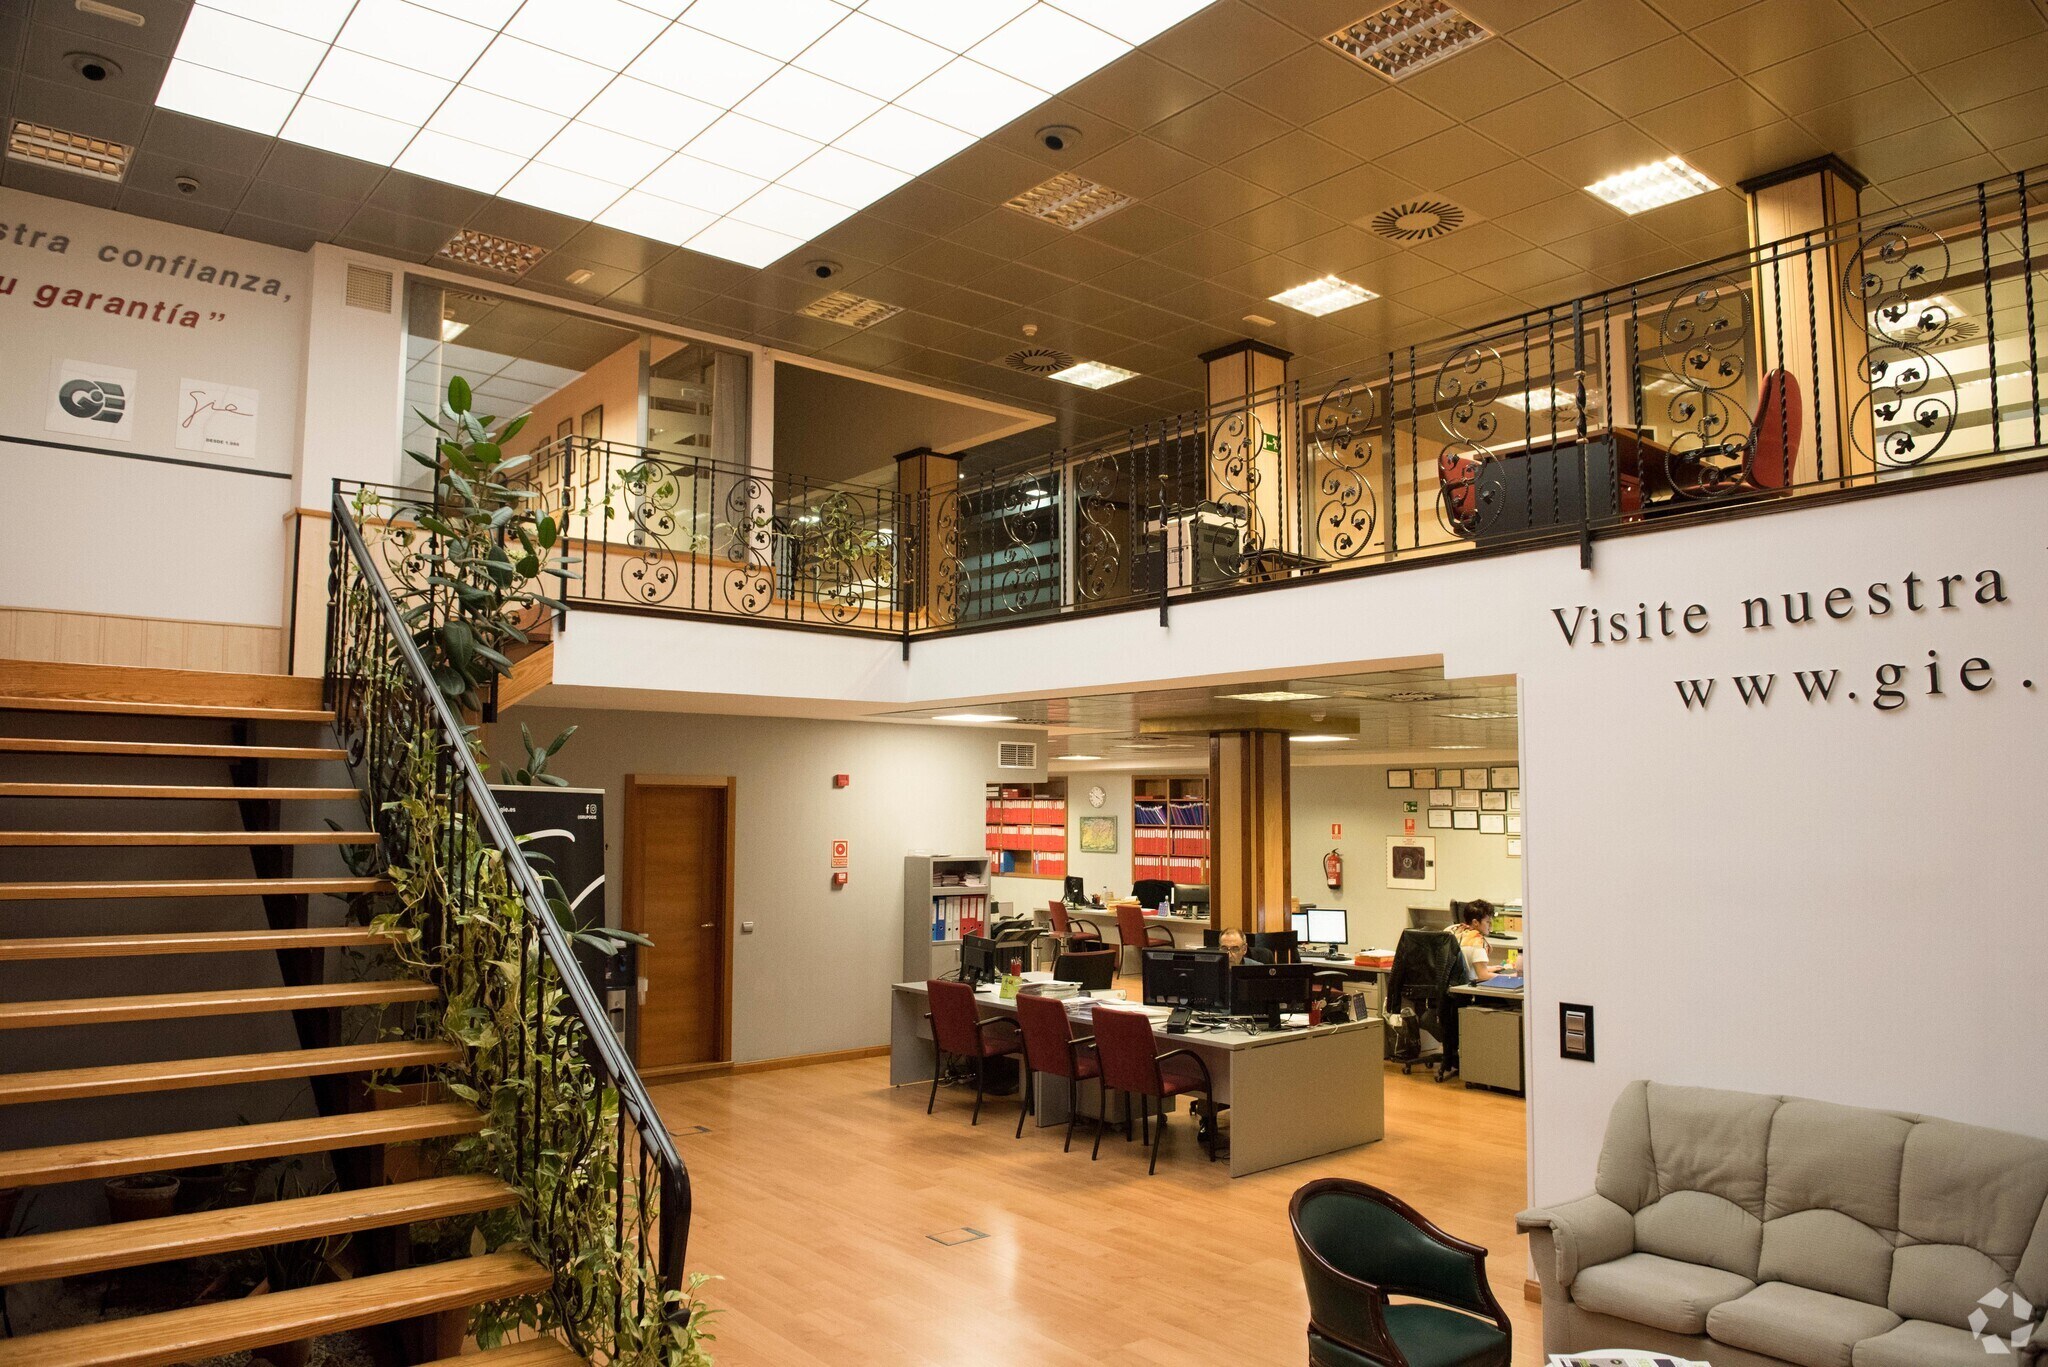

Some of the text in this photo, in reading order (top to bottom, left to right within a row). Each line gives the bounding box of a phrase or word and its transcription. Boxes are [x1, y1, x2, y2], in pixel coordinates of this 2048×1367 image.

[97, 245, 292, 303] confianza,
[1551, 568, 2007, 647] Visite nuestra
